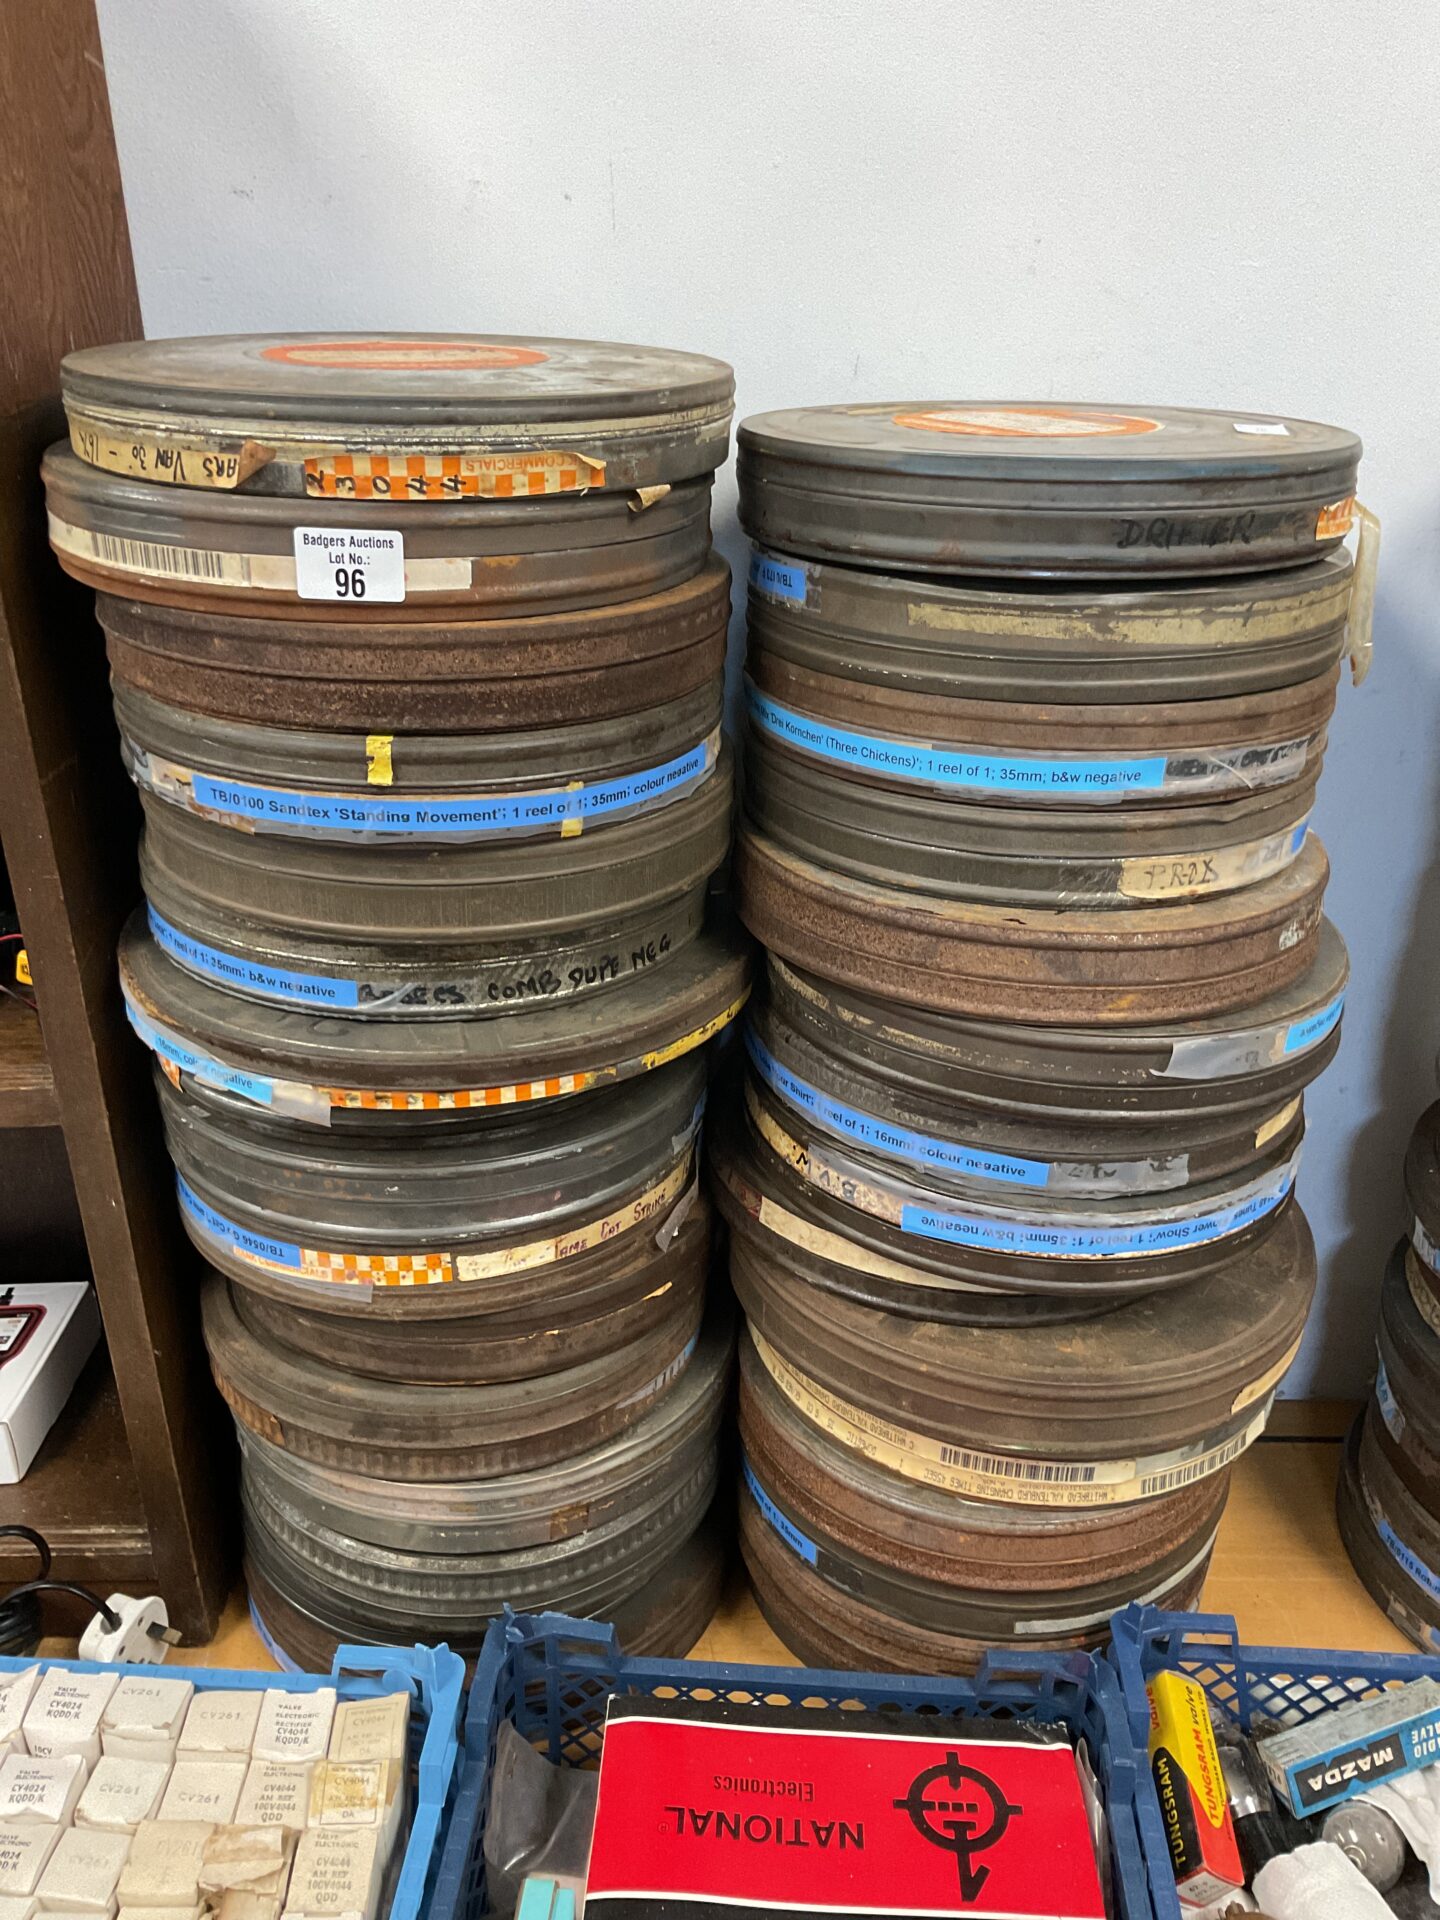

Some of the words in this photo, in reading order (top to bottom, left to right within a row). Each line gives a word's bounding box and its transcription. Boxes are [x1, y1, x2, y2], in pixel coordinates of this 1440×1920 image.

[154, 446, 187, 482] VAN
[303, 533, 346, 549] Badgers
[349, 536, 394, 549] Auctions
[329, 552, 345, 564] Lot
[349, 553, 371, 565] No.:
[335, 568, 366, 598] 96
[826, 735, 859, 755] (Three
[927, 759, 934, 772] 1
[938, 763, 963, 775] reel
[966, 765, 979, 777] of
[984, 766, 996, 780] 1;
[999, 768, 1047, 784] 35mm;
[1051, 770, 1082, 784] b&w
[1084, 770, 1142, 787] negative
[209, 786, 265, 811] TB/0100
[268, 800, 330, 820] Sandtex
[334, 807, 411, 823] 'Standing
[511, 805, 520, 819] 1
[525, 802, 553, 818] reel
[591, 785, 631, 807] 35mm;
[633, 775, 666, 795] colour
[667, 757, 700, 785] negative
[630, 932, 672, 971] NEG
[211, 957, 245, 979] 35mm;
[249, 969, 277, 987] b&w
[279, 979, 336, 999] negative
[844, 1117, 857, 1130] of
[859, 1123, 870, 1136] 1;
[919, 1145, 963, 1165] colour
[965, 1155, 1027, 1178] negative
[920, 1215, 980, 1235] negative
[46, 1709, 82, 1720] KQDD/K
[1184, 1684, 1199, 1730] valve
[274, 1735, 310, 1747] KQDD/K
[1191, 1727, 1220, 1822] TUNGSRAM
[1307, 1746, 1395, 1793] MAZDA
[8, 1793, 46, 1805] KQDD/K
[712, 1774, 815, 1803] Electronics
[260, 1812, 283, 1824] QDD
[663, 1805, 866, 1851] NATIONAL
[1157, 1756, 1187, 1870] TUNGSRAM
[315, 1892, 339, 1905] QDD
